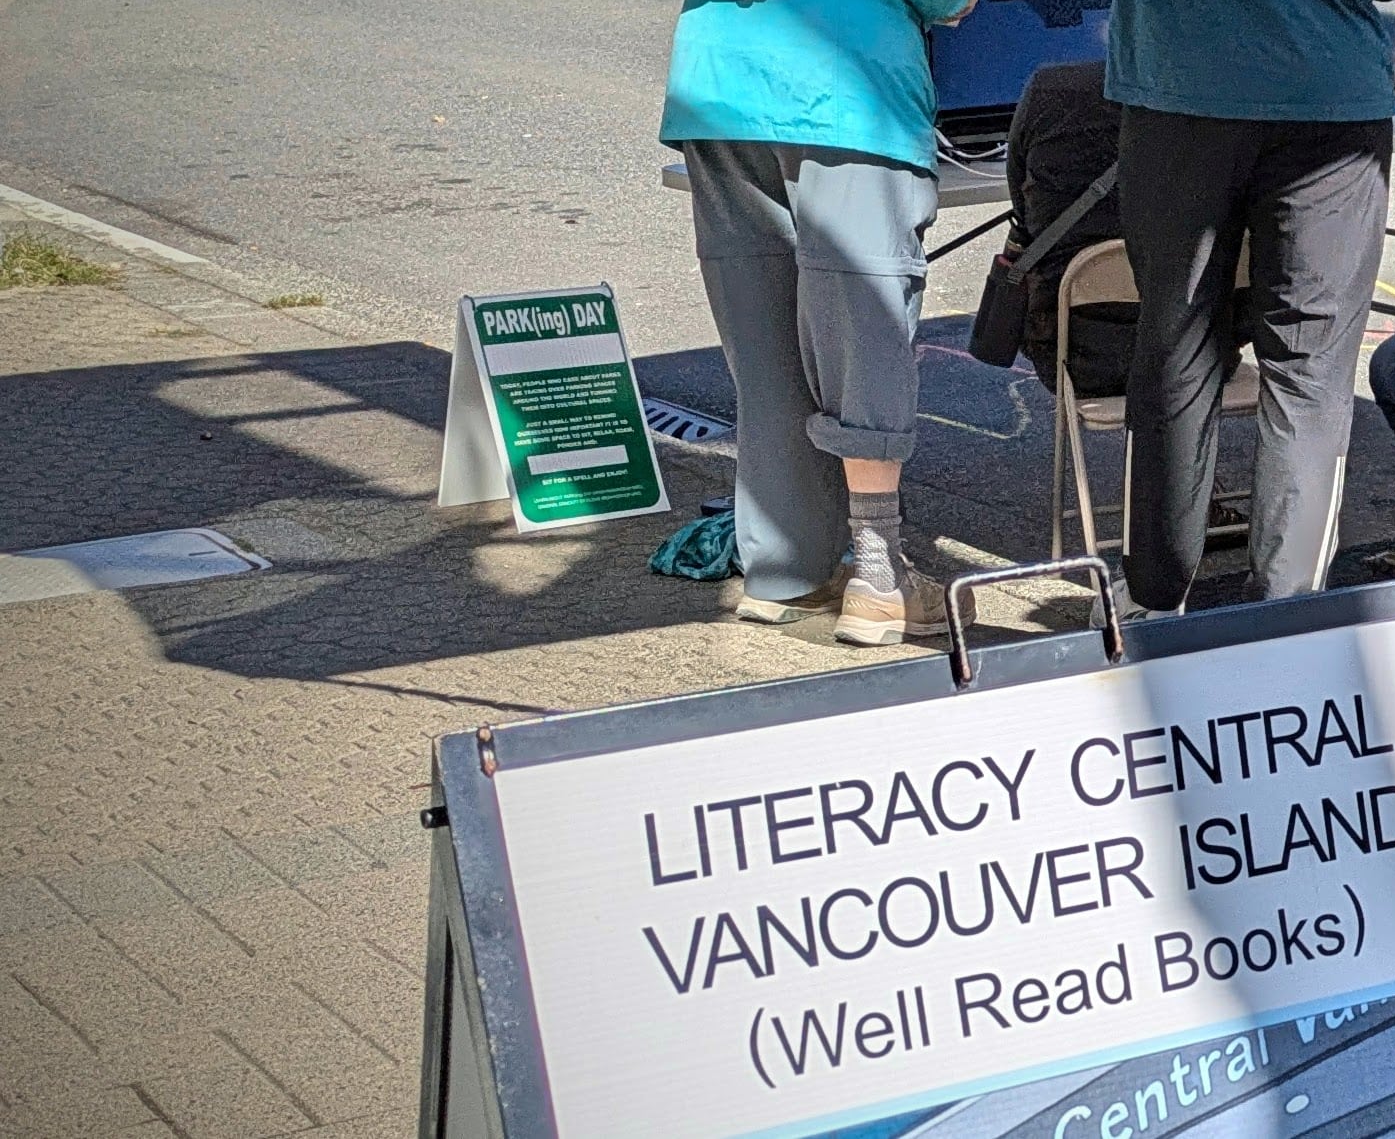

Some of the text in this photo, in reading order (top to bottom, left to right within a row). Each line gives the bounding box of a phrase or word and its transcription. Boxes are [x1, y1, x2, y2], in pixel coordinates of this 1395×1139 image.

[482, 301, 606, 338] PARK(ing) DAY
[644, 694, 1395, 887] LITERACY CENTRAL
[642, 835, 1155, 995] VANCOUVER
[749, 884, 1366, 1089] (Well Read Books)
[1053, 1028, 1270, 1139] Central
